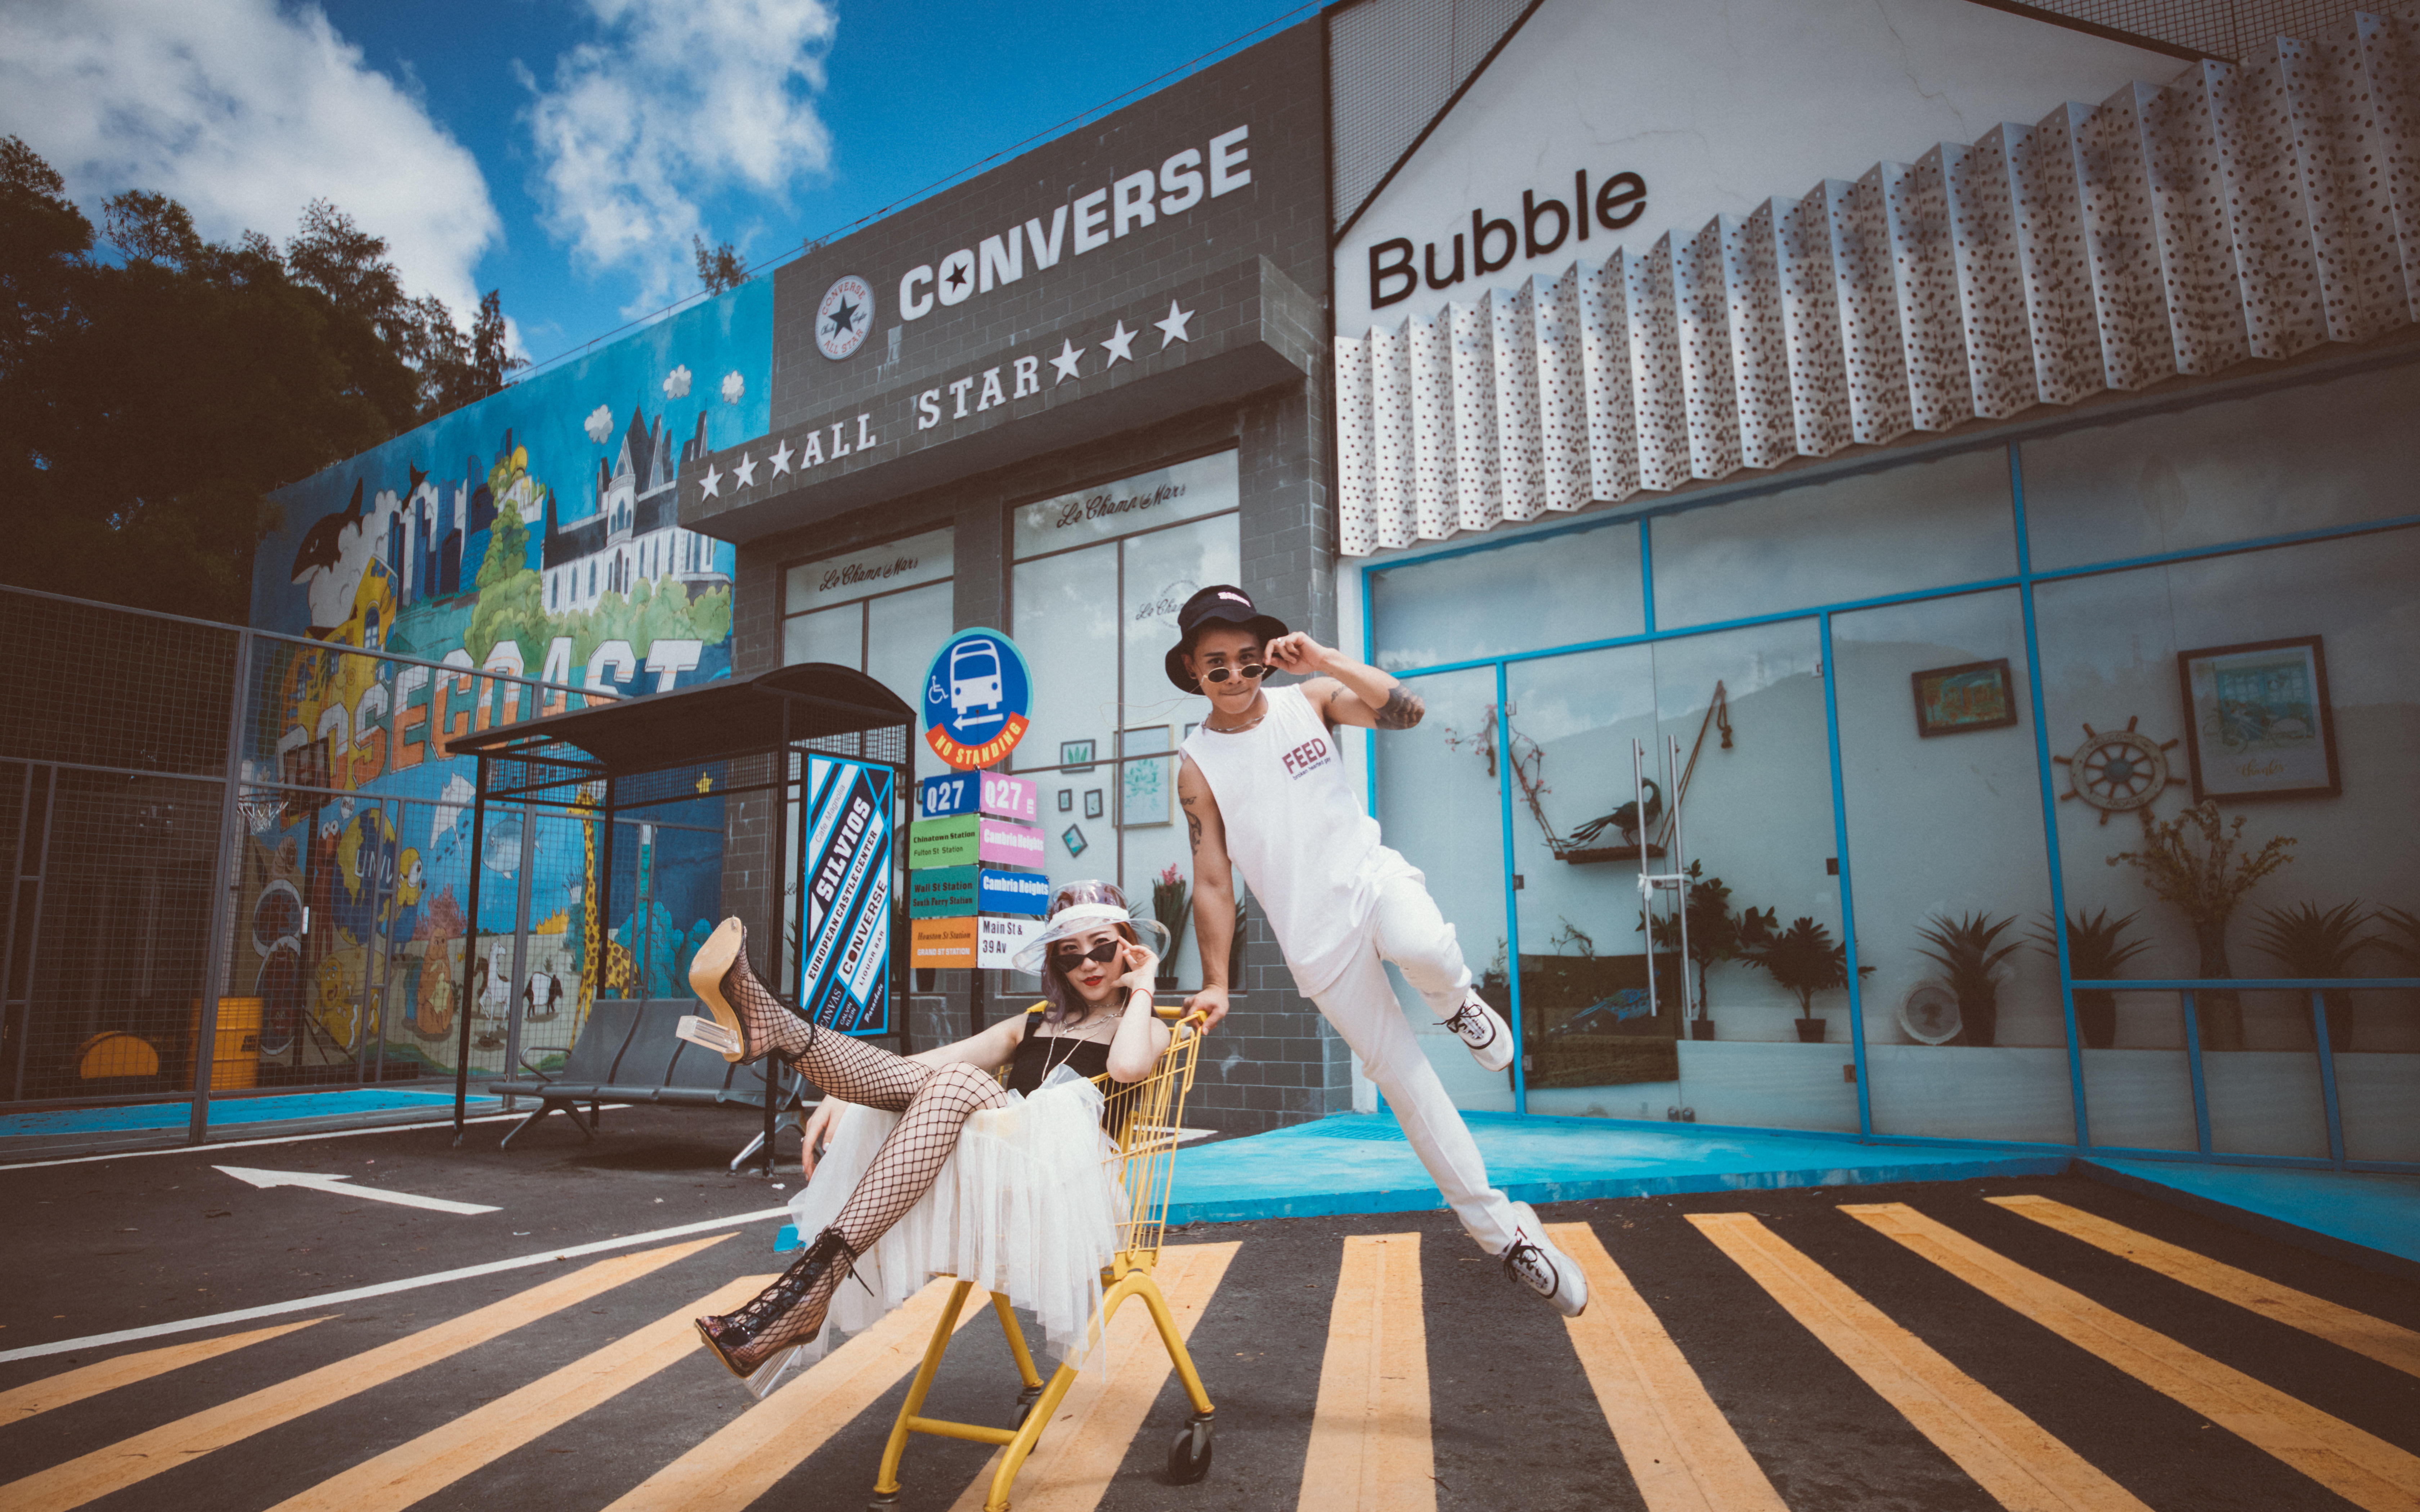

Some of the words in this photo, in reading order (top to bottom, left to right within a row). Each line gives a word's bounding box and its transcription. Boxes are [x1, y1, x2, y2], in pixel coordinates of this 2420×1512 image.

[899, 124, 1251, 321] CONVERSE
[1369, 168, 1647, 310] Bubble
[822, 282, 866, 315] CONVERSE
[824, 340, 838, 354] ALL
[842, 328, 863, 353] STAR
[801, 413, 876, 469] ALL
[918, 355, 1040, 430] STAR
[1057, 502, 1083, 528] Le
[1086, 494, 1137, 519] Champ
[1153, 483, 1186, 506] Mars
[819, 569, 840, 591] Le
[842, 563, 882, 585] Champ
[893, 556, 918, 576] Mars
[1135, 603, 1153, 620] Le
[935, 735, 953, 756] NO
[956, 722, 1022, 765] STANDING
[1281, 738, 1326, 774] FEED
[1292, 769, 1309, 780] broken
[1308, 760, 1324, 770] hearted
[342, 798, 354, 811] Hello
[927, 780, 964, 813] Q27
[985, 779, 1022, 810] Q27
[815, 823, 828, 842] Cafe
[825, 785, 845, 822] Magnolia
[816, 796, 870, 902] SILVIOS
[914, 835, 949, 843] Chinatown
[984, 828, 1017, 847] Cambria
[1018, 834, 1044, 851] Heights
[914, 883, 930, 893] Wall
[932, 883, 940, 892] St
[942, 881, 973, 891] Station
[983, 875, 1018, 892] Cambria
[1019, 879, 1049, 896] Heights
[808, 917, 839, 980] EUROPEAN
[835, 873, 859, 918] CASTLE
[855, 830, 878, 874] CENTER
[913, 897, 930, 907] South
[950, 896, 973, 905] Station
[842, 880, 887, 975] CONVERSE
[874, 930, 884, 949] BAR
[917, 932, 942, 940] Houston
[942, 931, 949, 940] St
[949, 931, 971, 940] Station
[983, 921, 1005, 934] Main
[1007, 922, 1016, 935] St
[1018, 924, 1022, 935] &
[982, 940, 994, 953] 39
[996, 940, 1007, 953] Av
[820, 989, 842, 1027] CANVAS
[840, 1002, 853, 1025] CALVIN
[845, 1007, 856, 1027] KLEIN
[864, 983, 884, 1023] Parachute
